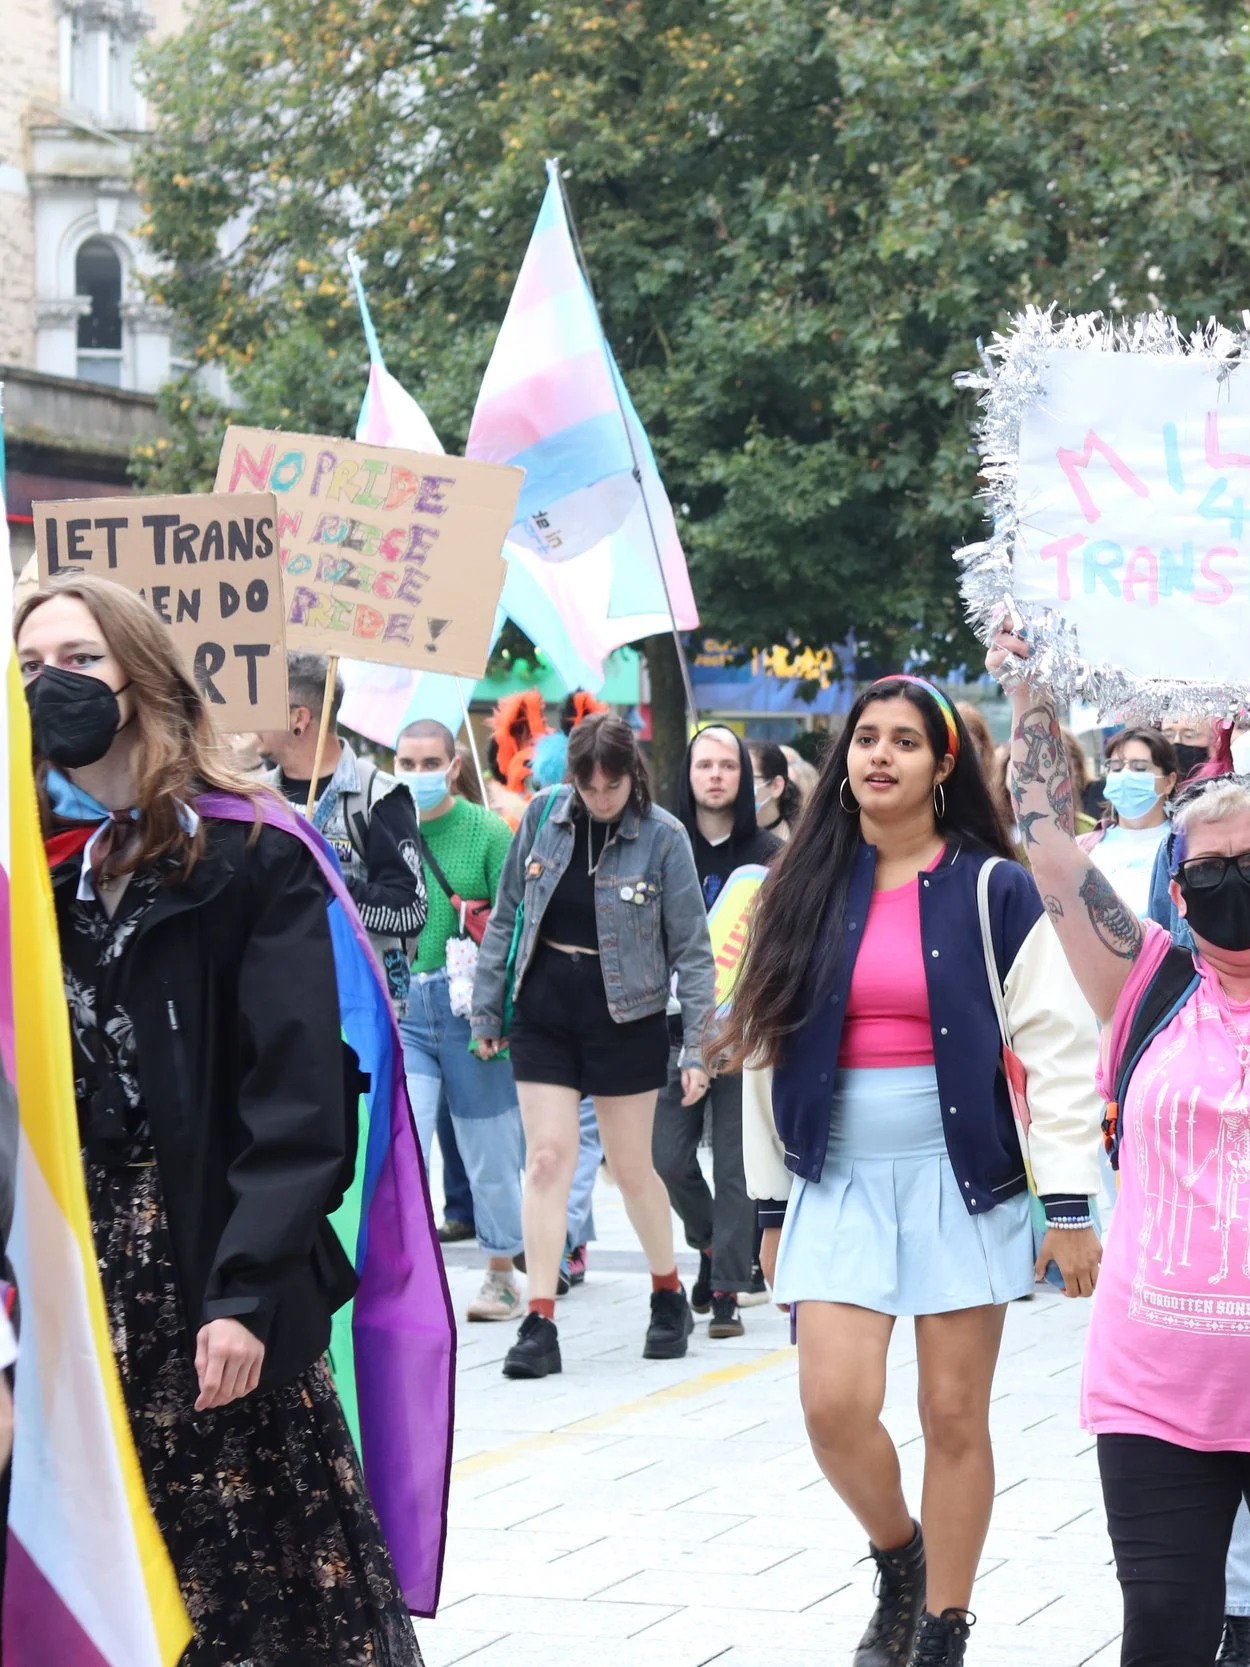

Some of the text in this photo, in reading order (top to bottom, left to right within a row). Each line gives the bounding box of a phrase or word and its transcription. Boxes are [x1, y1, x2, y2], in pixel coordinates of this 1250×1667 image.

[228, 443, 457, 518] NO PRIDE
[45, 514, 275, 576] LET TRANS
[1040, 533, 1238, 606] TRANS
[219, 578, 270, 619] DO
[1142, 1289, 1214, 1314] FORGOTTEN
